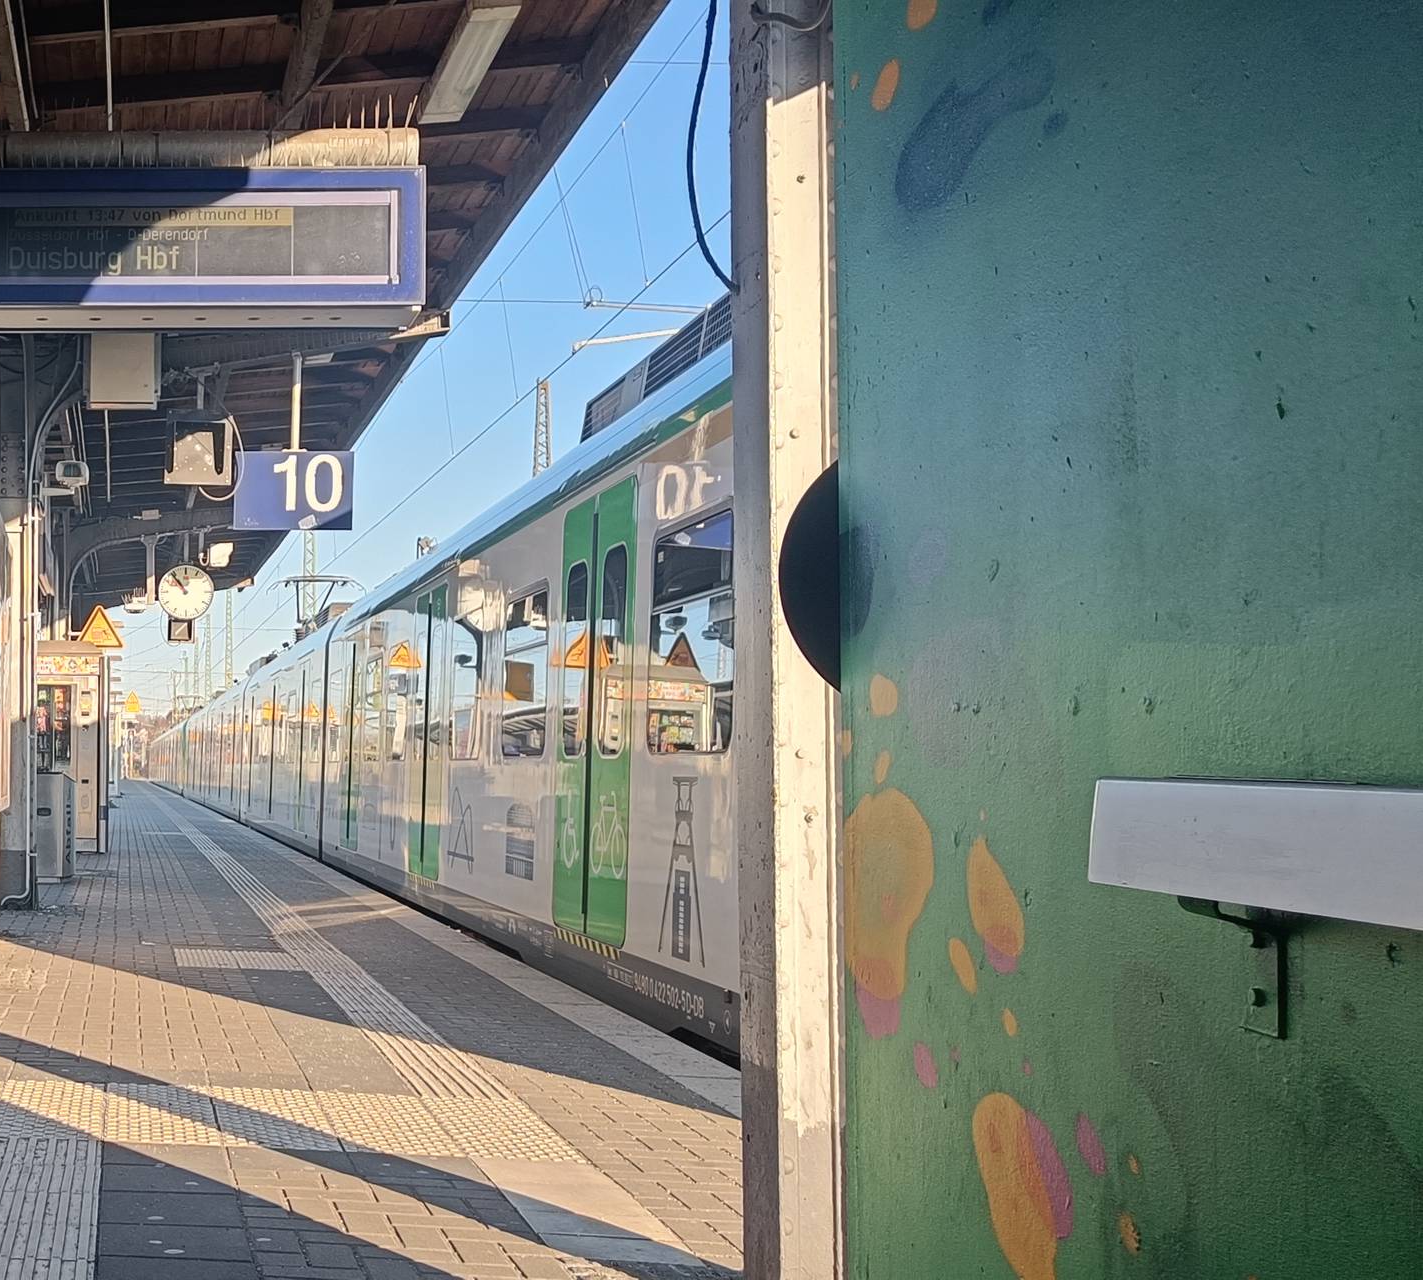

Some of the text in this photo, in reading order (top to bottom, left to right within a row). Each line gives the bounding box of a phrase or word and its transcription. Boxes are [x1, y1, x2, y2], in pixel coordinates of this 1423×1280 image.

[16, 208, 281, 222] Ankunft 13:47 von Dortmund Hbf
[128, 228, 210, 242] D-Derendorf
[8, 246, 180, 276] Duisburg Hbf
[273, 454, 343, 512] 10
